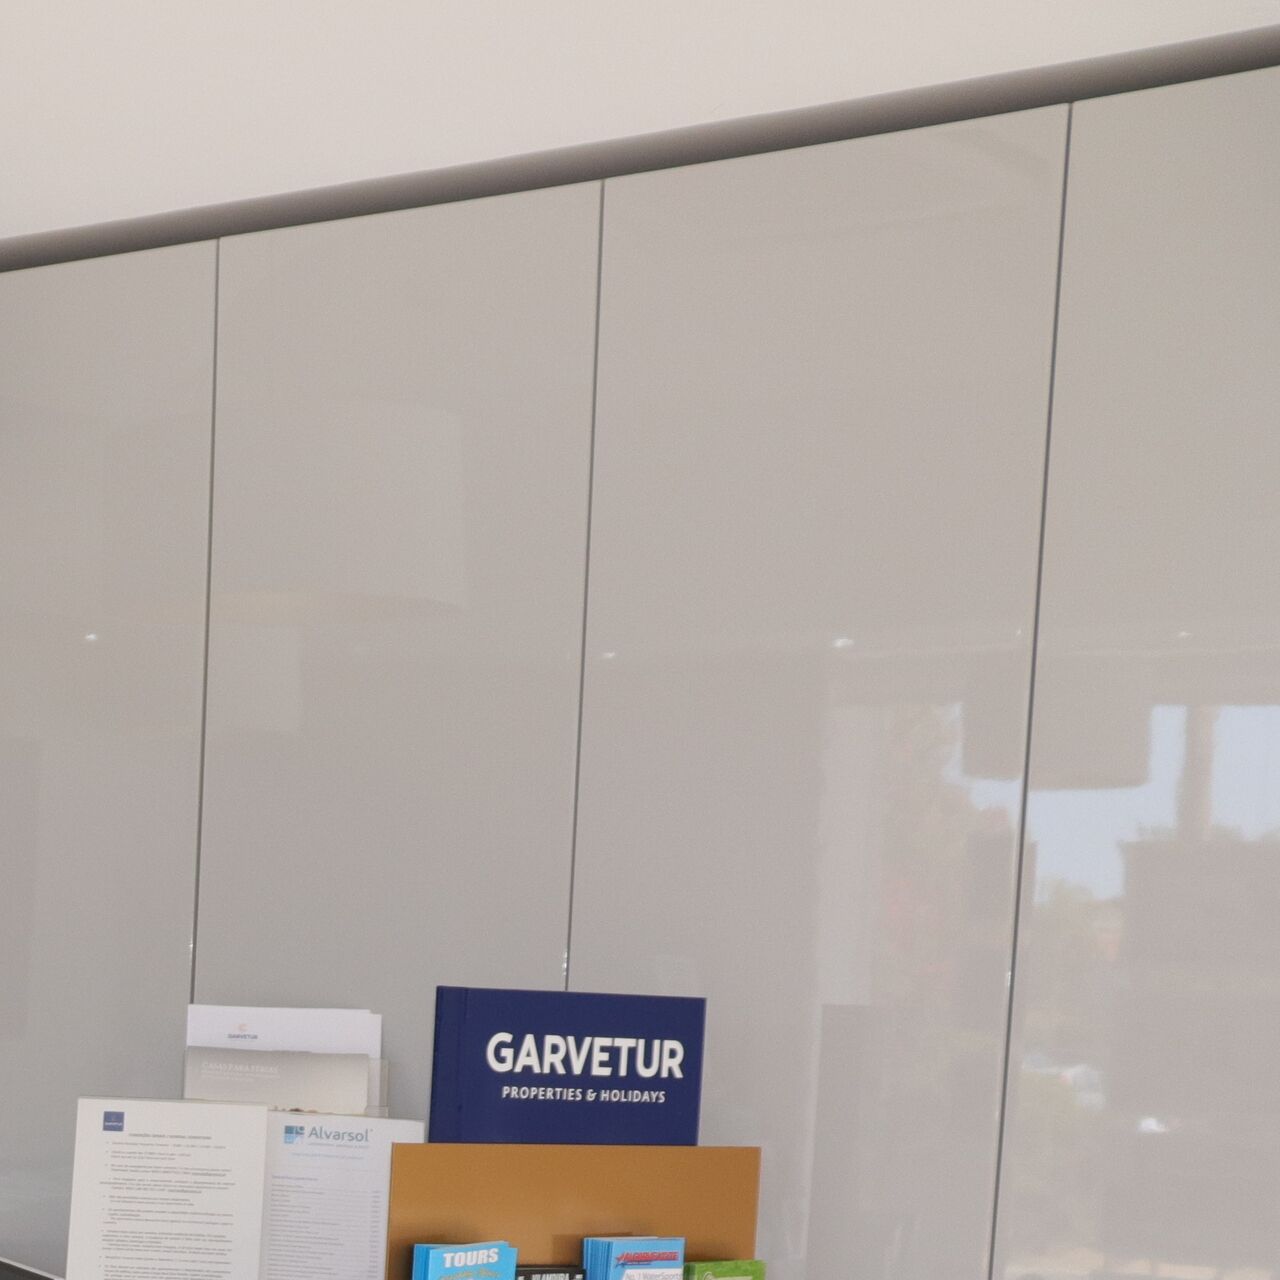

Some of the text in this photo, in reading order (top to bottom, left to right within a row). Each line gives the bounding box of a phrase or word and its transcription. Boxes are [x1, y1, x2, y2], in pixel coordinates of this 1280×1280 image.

[486, 1032, 685, 1078] GARVETUR
[502, 1086, 665, 1103] PROPERTIES & HOLIDAYS
[308, 1126, 369, 1142] Alvarsol
[443, 1248, 499, 1268] TOURS
